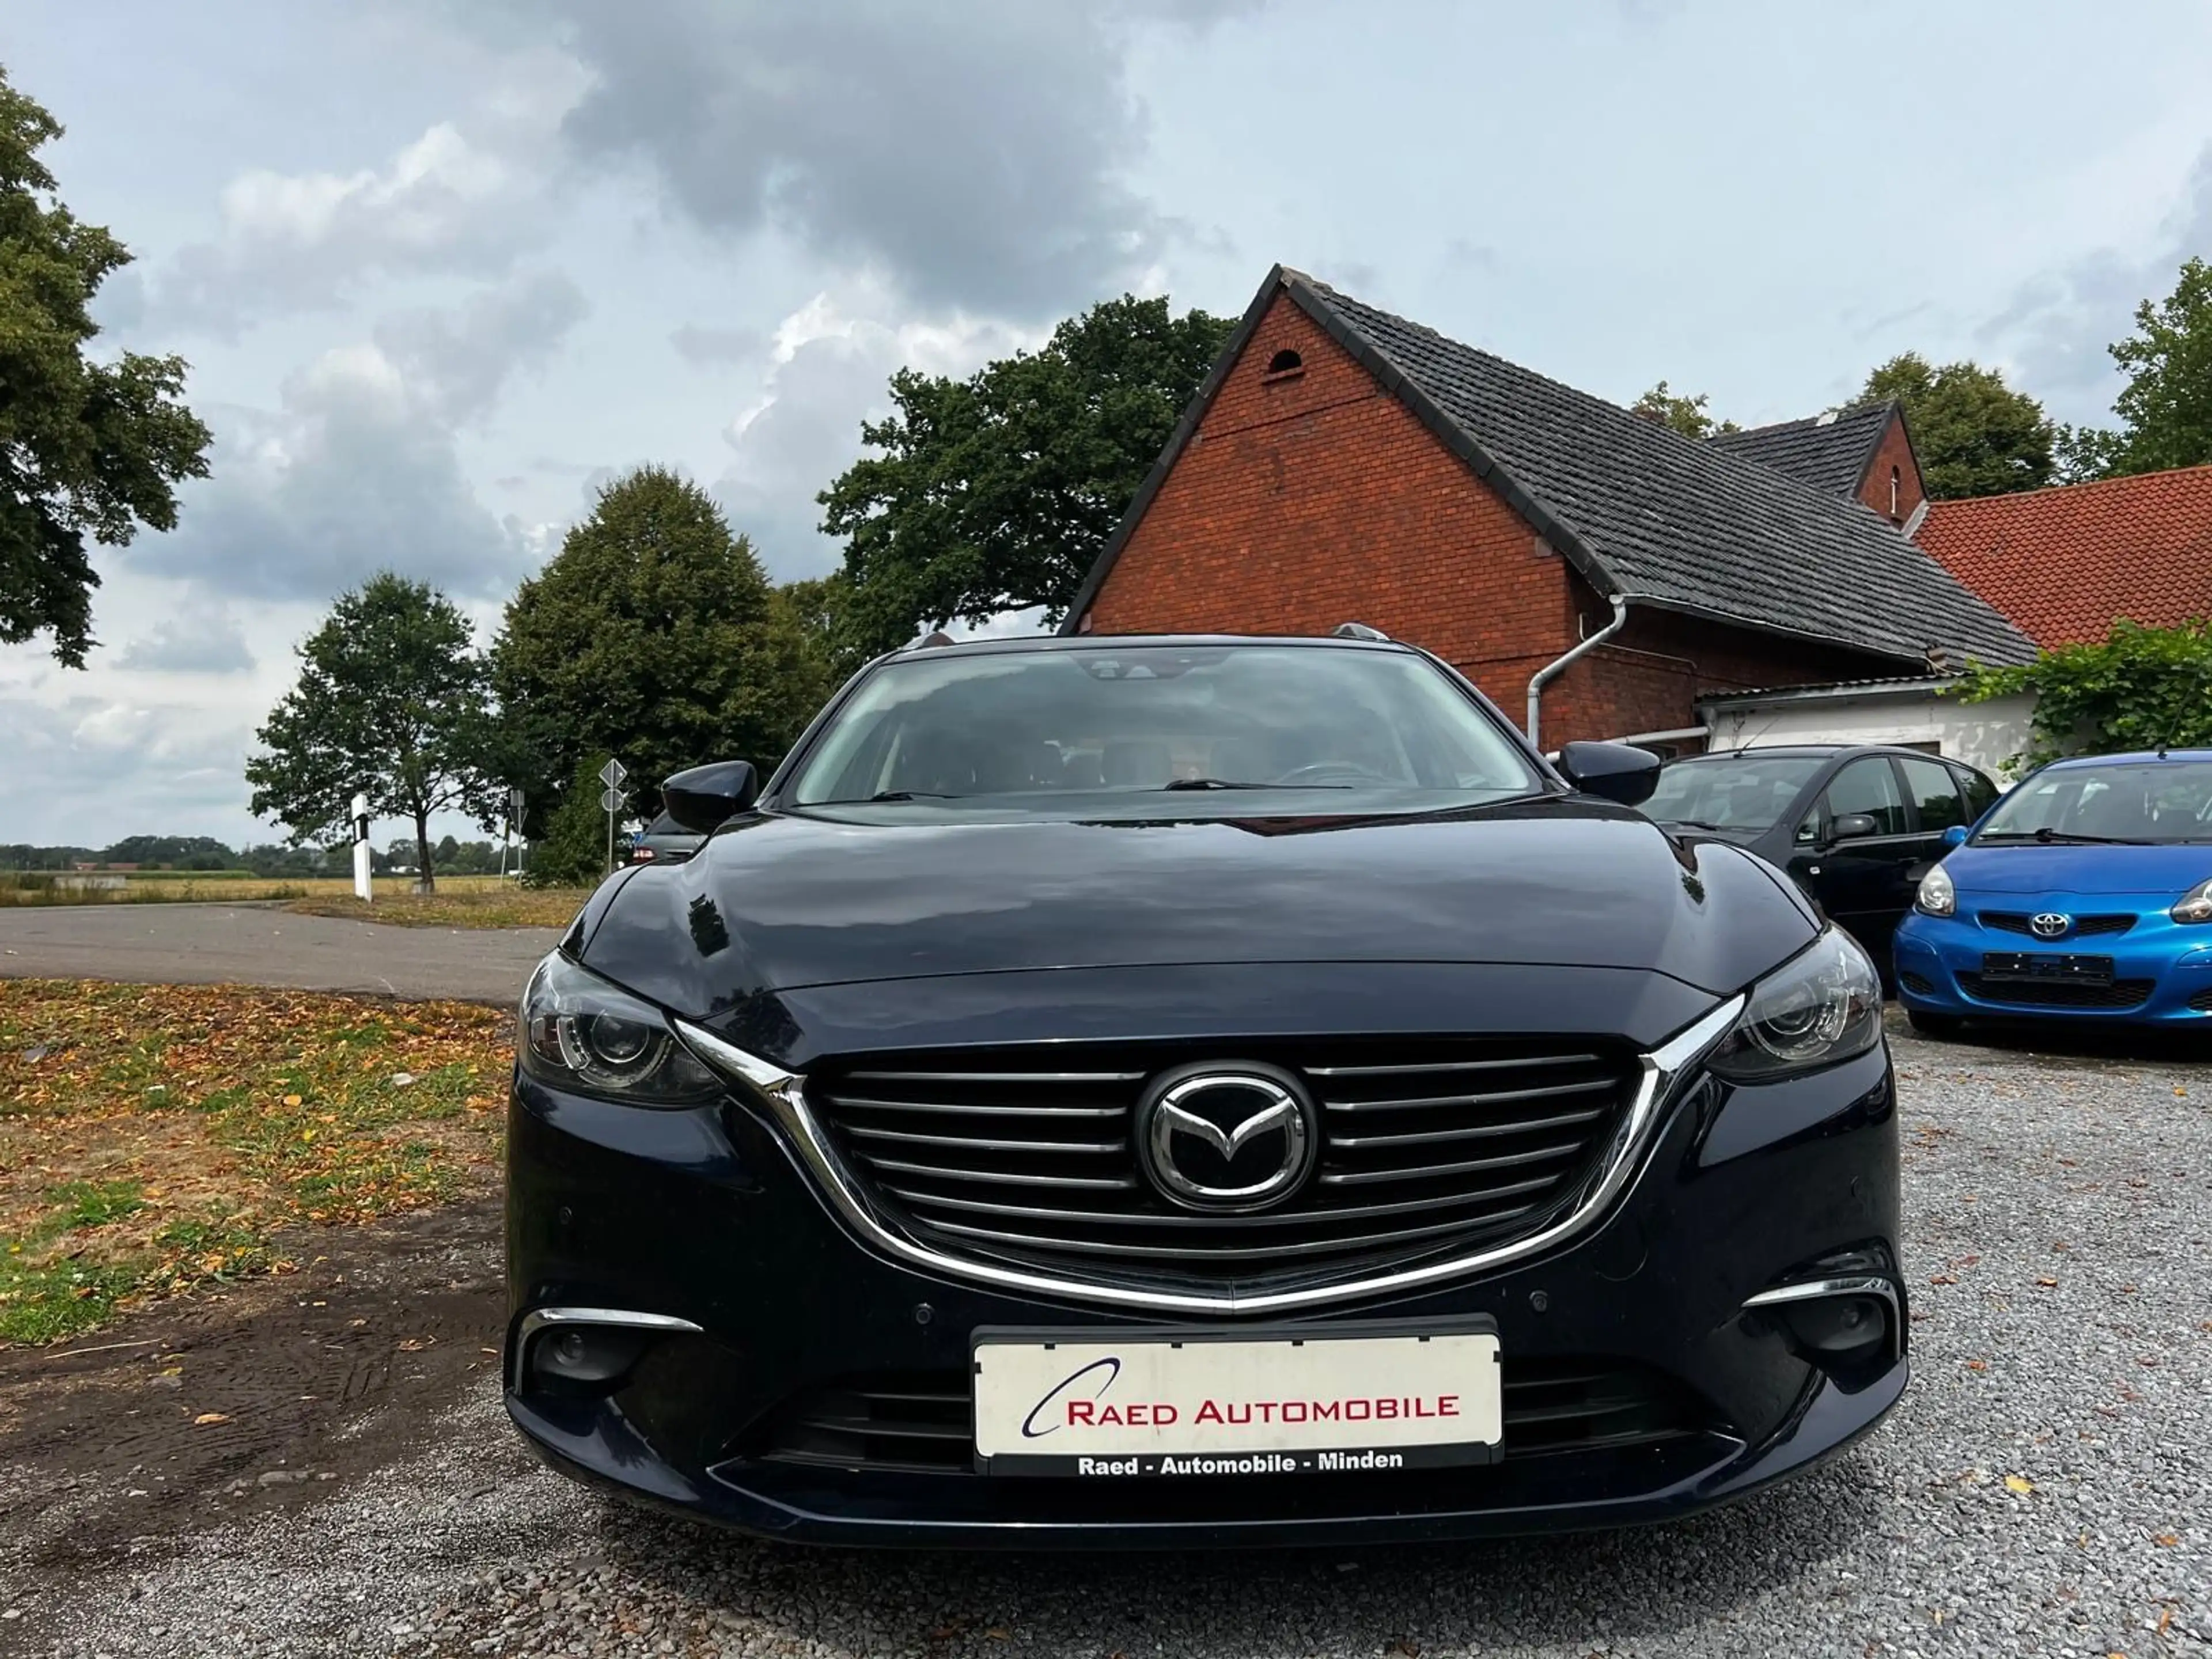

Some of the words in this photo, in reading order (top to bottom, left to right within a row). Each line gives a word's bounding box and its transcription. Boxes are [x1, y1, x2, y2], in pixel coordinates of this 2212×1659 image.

[1078, 1457, 1138, 1475] Raed
[1160, 1455, 1296, 1474] Automobile
[1318, 1450, 1403, 1470] Minden
